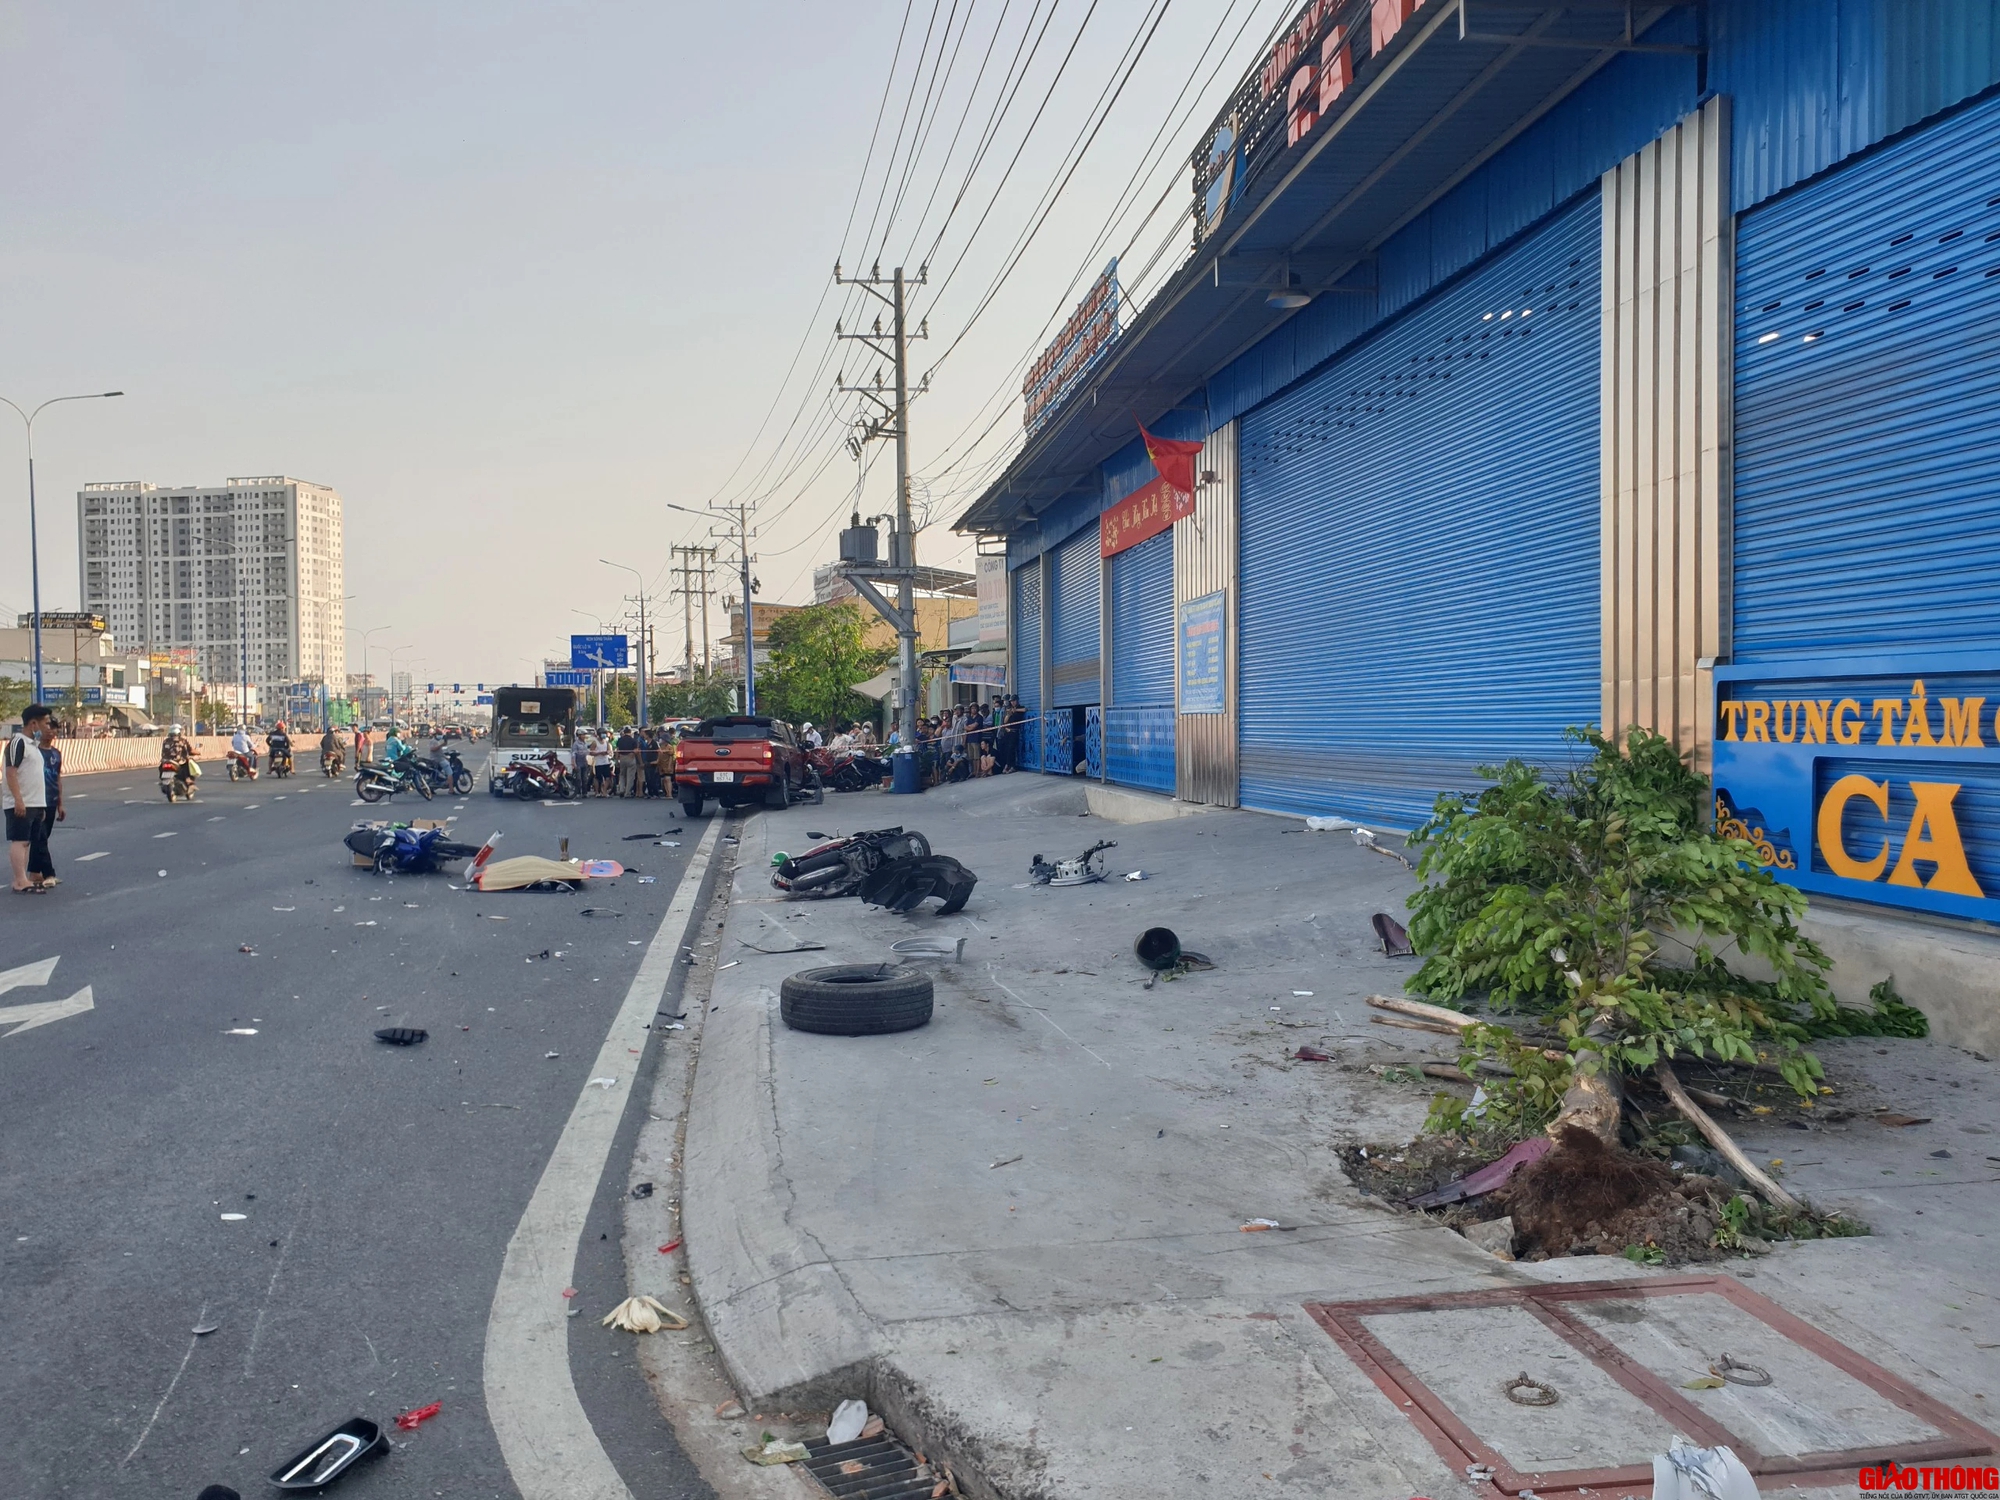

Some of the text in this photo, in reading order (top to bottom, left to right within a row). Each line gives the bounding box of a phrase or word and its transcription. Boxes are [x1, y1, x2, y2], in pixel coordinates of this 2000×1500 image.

[1720, 698, 1865, 744] TRUNG
[1873, 679, 1986, 747] TÂM
[1817, 774, 1986, 898] CA
